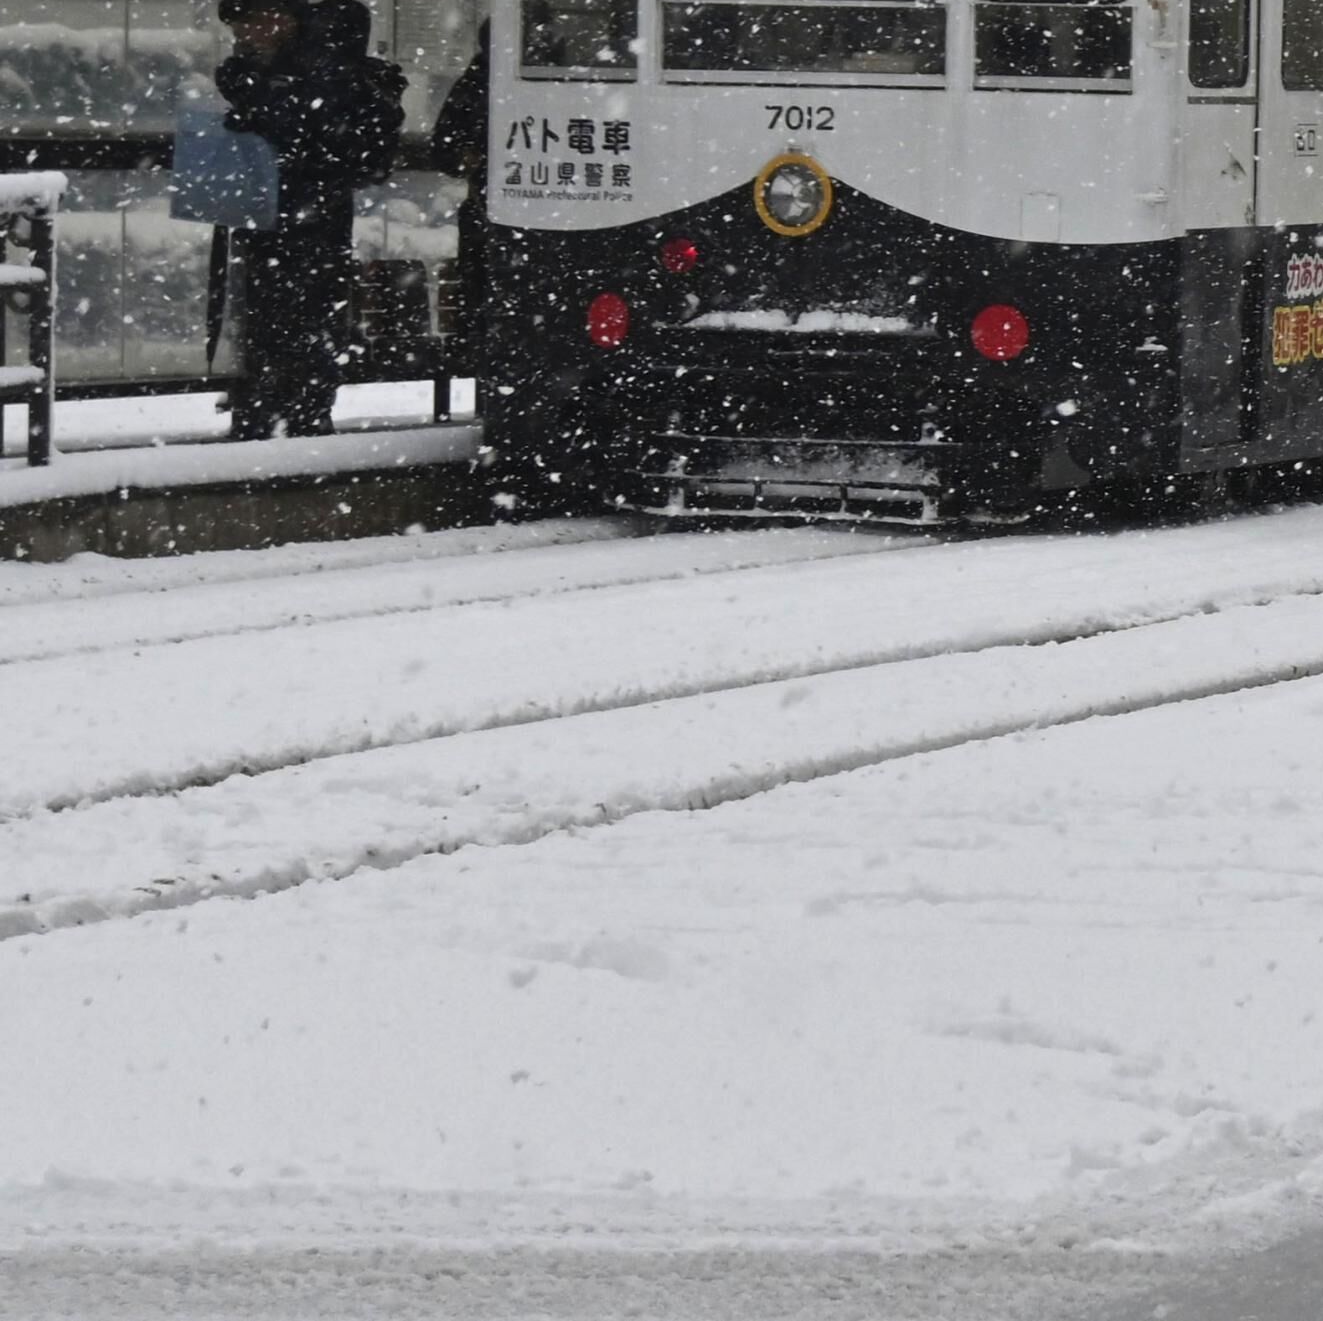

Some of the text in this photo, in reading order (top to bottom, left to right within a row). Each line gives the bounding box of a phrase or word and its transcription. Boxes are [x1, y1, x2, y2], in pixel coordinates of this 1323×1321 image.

[765, 105, 834, 130] 7012
[506, 115, 631, 155] パト電車
[504, 161, 631, 187] 富山県警察
